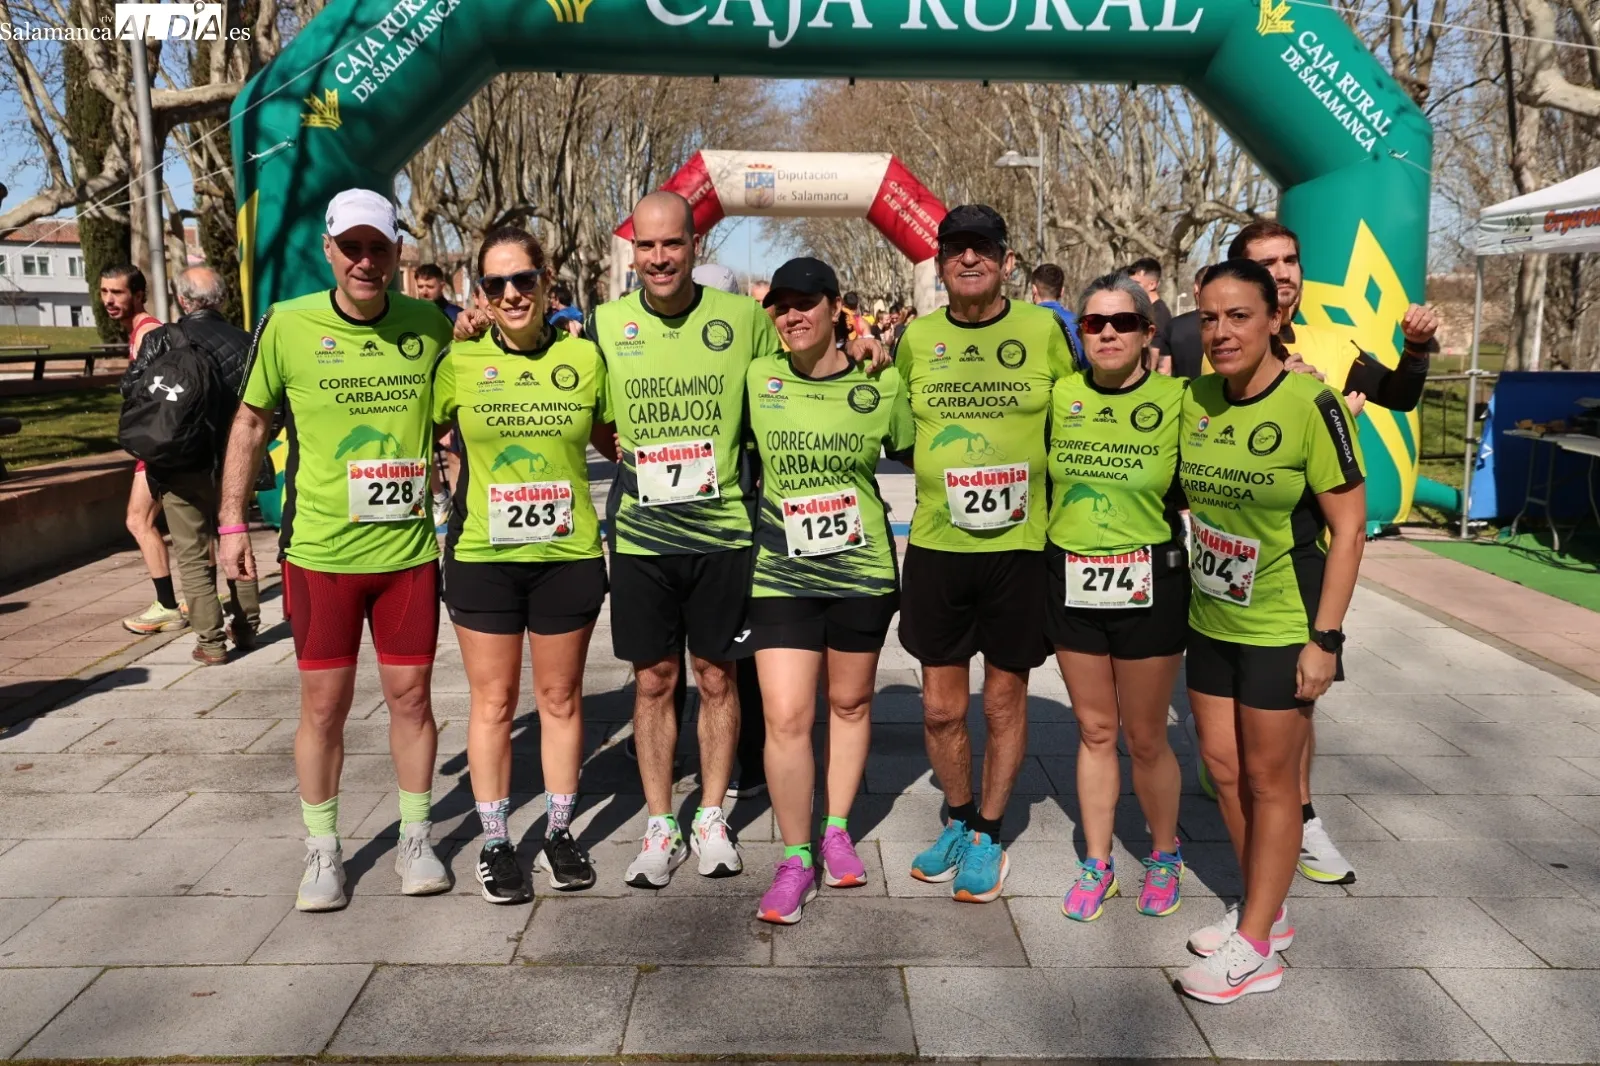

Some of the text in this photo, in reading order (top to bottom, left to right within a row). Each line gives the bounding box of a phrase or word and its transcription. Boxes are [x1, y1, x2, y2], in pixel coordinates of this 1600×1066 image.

[335, 36, 385, 84] CAJA
[352, 0, 460, 103] DE SALAMANCA
[1298, 31, 1392, 137] CAJA RURAL
[1280, 45, 1376, 152] DE SALAMANCA
[777, 169, 839, 182] Diputación
[777, 191, 849, 202] de Salamanca
[889, 181, 909, 202] CON
[883, 193, 939, 249] DEPORTISTAS
[319, 373, 427, 390] CORRECAMINOS
[625, 374, 724, 399] CORRECAMINOS
[922, 381, 1031, 394] CORRECAMINOS
[335, 389, 418, 403] CARBAJOSA
[927, 395, 1019, 407] CARBAJOSA
[349, 404, 408, 416] SALAMANCA
[473, 402, 583, 414] CORRECAMINOS
[628, 400, 722, 424] CARBAJOSA
[940, 411, 1005, 419] SALAMANCA
[486, 415, 573, 426] CARBAJOSA
[499, 429, 562, 438] SALAMANCA
[634, 424, 721, 440] SALAMANCA
[766, 430, 865, 453] CORRECAMINOS
[1330, 408, 1353, 463] CARBAJOSA
[1051, 437, 1160, 456] CORRECAMINOS
[770, 454, 857, 475] CARBAJOSA
[1056, 452, 1144, 469] CARBAJOSA
[666, 463, 682, 487] 7
[778, 475, 859, 491] SALAMANCA
[946, 468, 1027, 488] bedunia
[1065, 467, 1128, 481] SALAMANCA
[368, 480, 413, 506] 228
[490, 485, 570, 503] bedunia
[963, 487, 1011, 514] 261
[1190, 495, 1241, 510] SALAMANCA
[507, 503, 556, 528] 263
[801, 512, 848, 540] 125
[1190, 516, 1256, 559] bedunia
[1194, 543, 1233, 583] 204
[1082, 567, 1134, 591] 274
